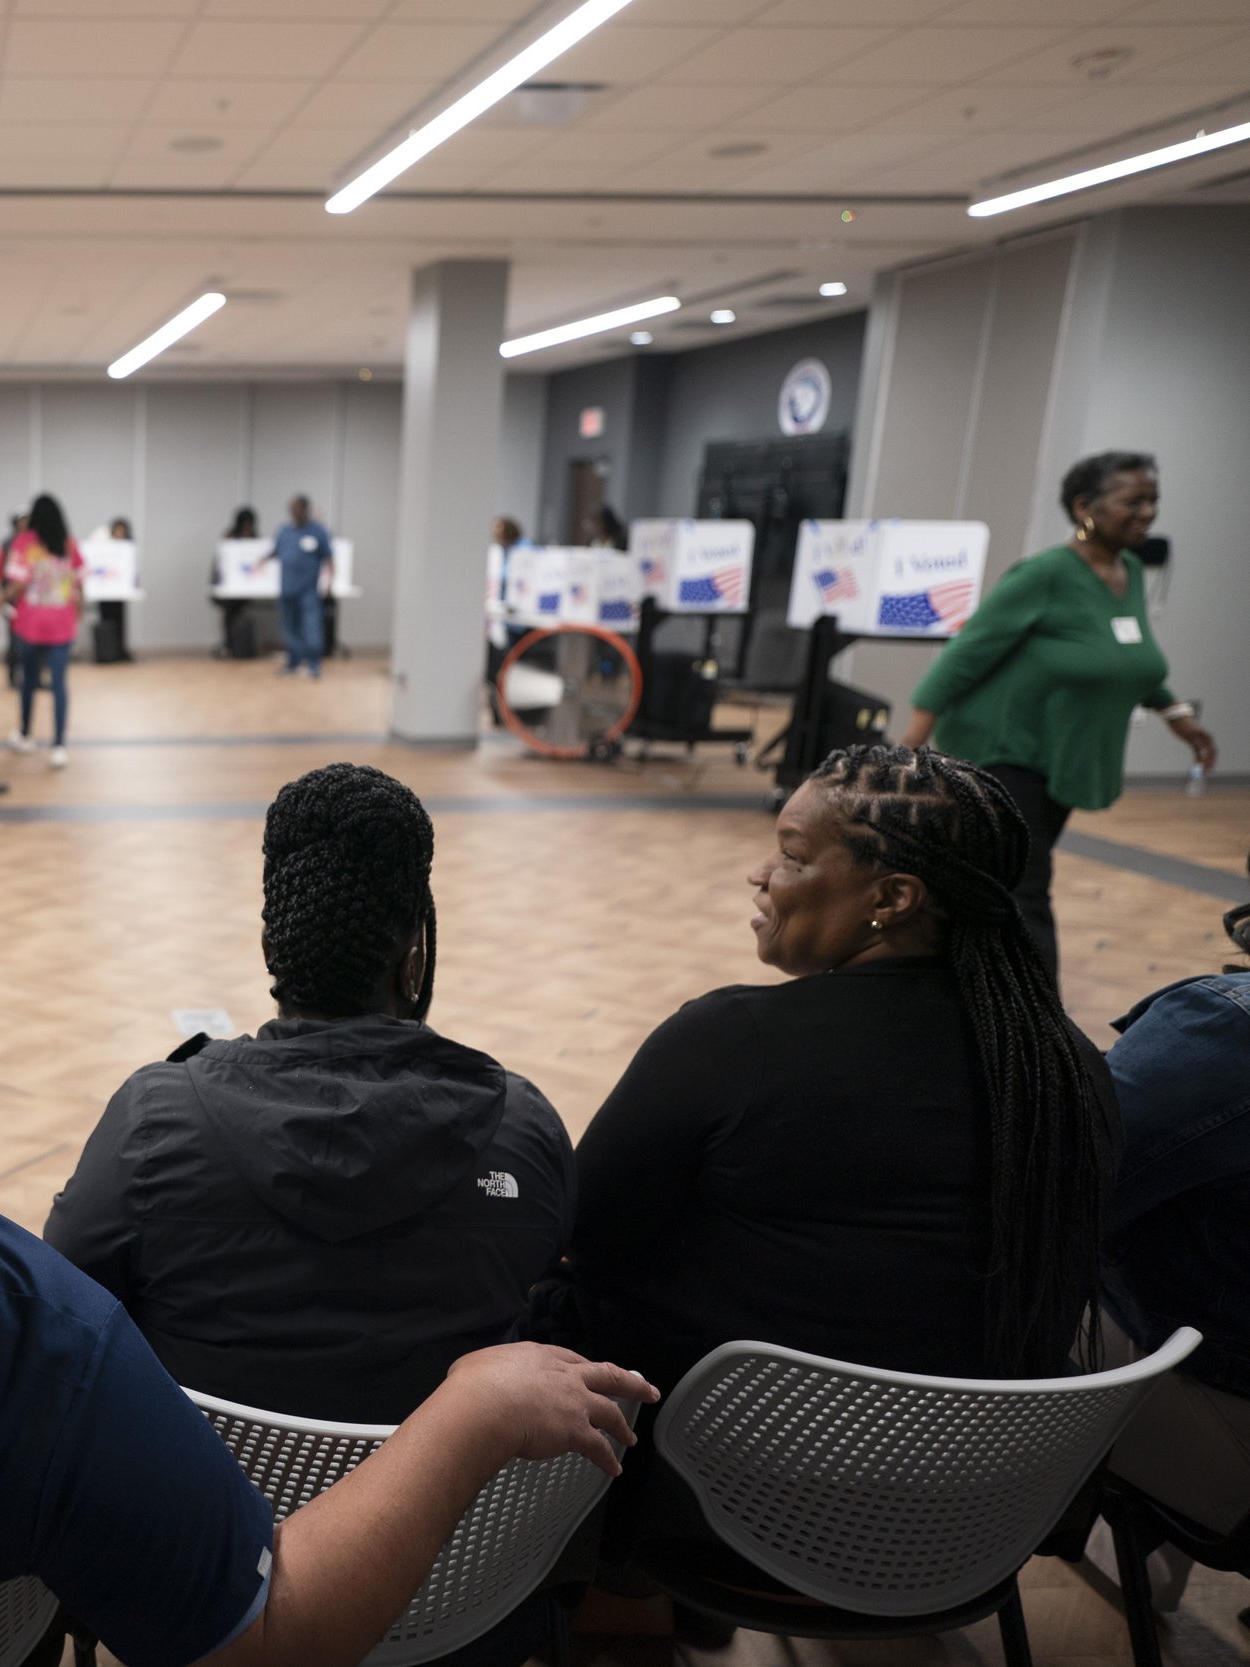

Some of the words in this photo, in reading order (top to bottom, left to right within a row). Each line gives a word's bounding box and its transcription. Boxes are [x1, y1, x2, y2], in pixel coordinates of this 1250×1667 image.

[894, 557, 904, 578] I
[910, 547, 968, 573] Voted
[489, 1171, 505, 1180] THE
[477, 1178, 504, 1188] NORTH
[486, 1187, 506, 1196] FACE
